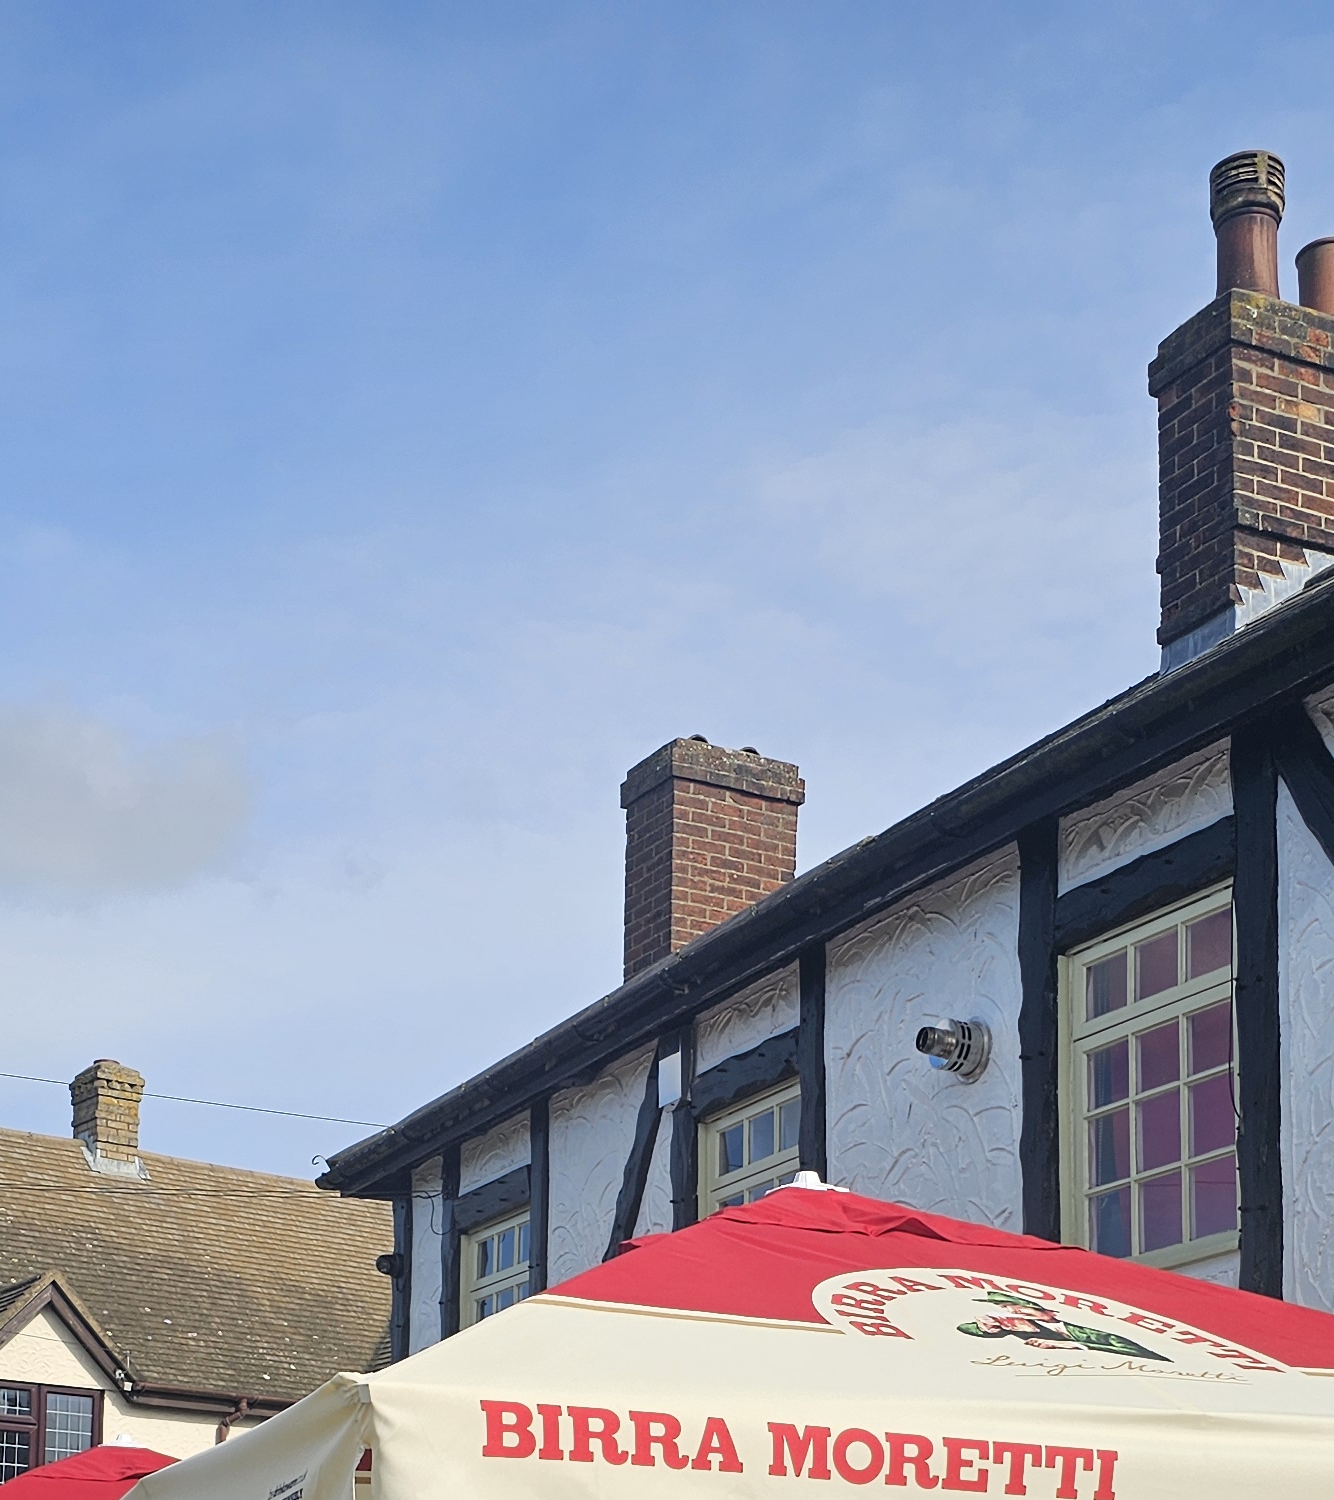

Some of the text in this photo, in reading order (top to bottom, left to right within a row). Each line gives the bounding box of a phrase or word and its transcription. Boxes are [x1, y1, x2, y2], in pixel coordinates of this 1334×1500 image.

[831, 1274, 1286, 1373] BIRRA MORETTI
[970, 1355, 1249, 1382] Luigi Moretti
[479, 1400, 744, 1473] BIRRA
